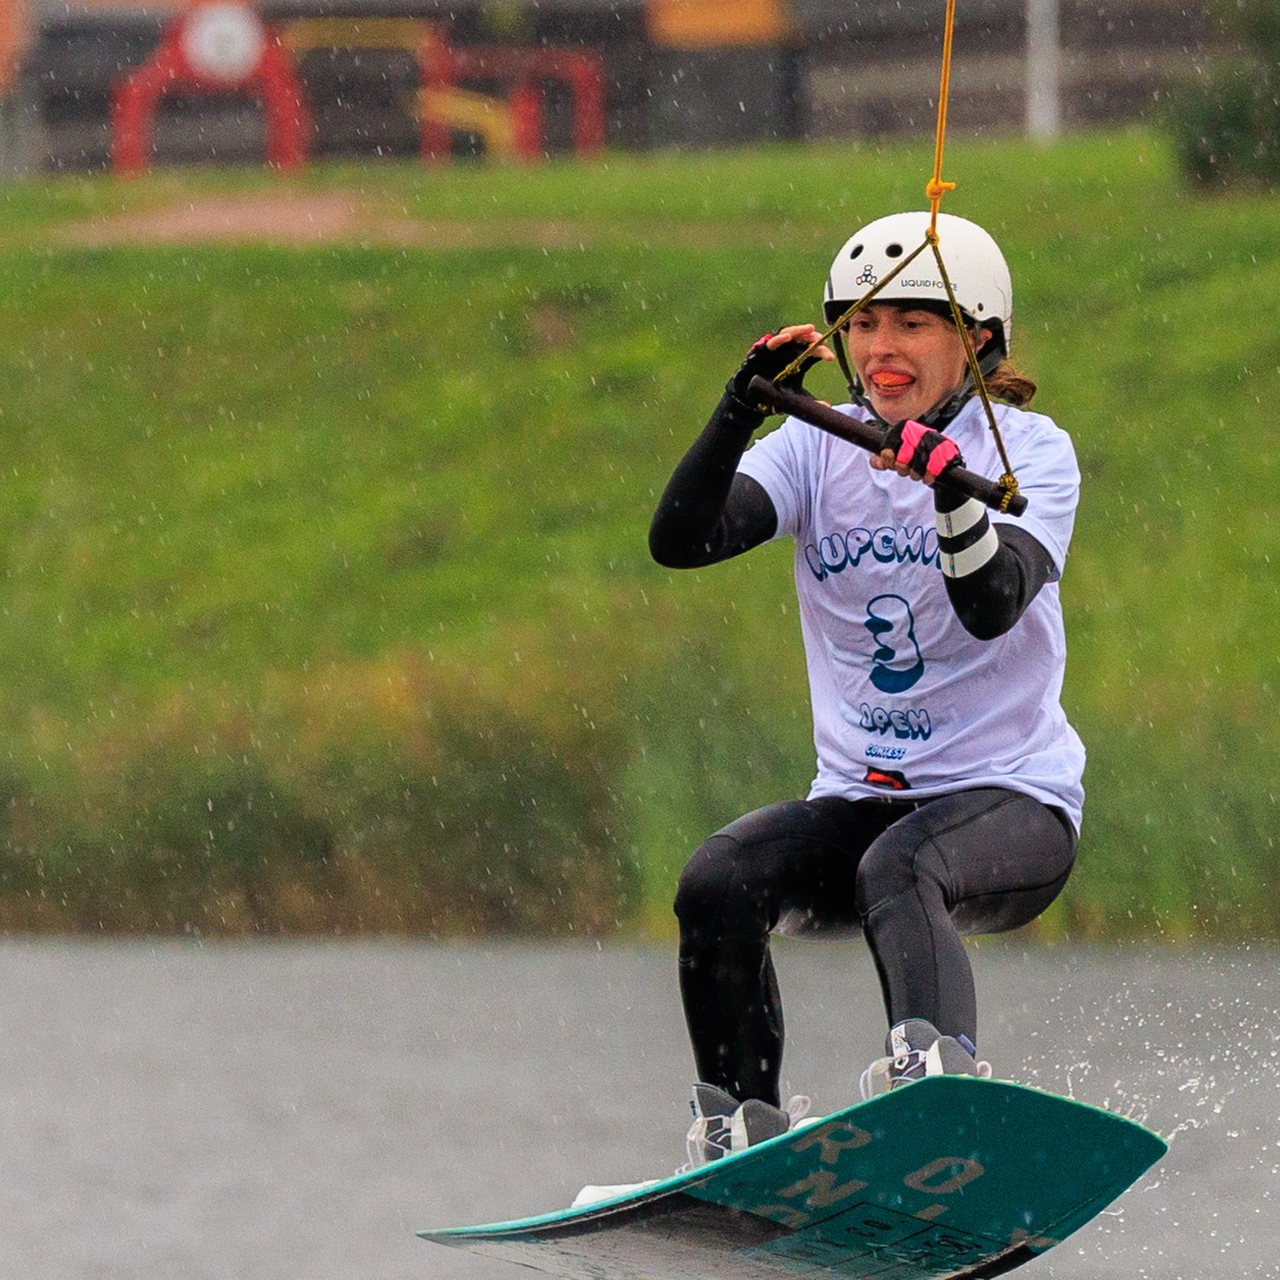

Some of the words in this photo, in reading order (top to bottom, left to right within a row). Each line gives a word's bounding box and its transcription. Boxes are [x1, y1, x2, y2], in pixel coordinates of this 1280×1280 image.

[901, 279, 931, 289] LIQUID
[932, 280, 958, 292] FOCE
[864, 594, 924, 694] 3
[860, 702, 932, 741] OPEN
[865, 743, 907, 760] CONTEST
